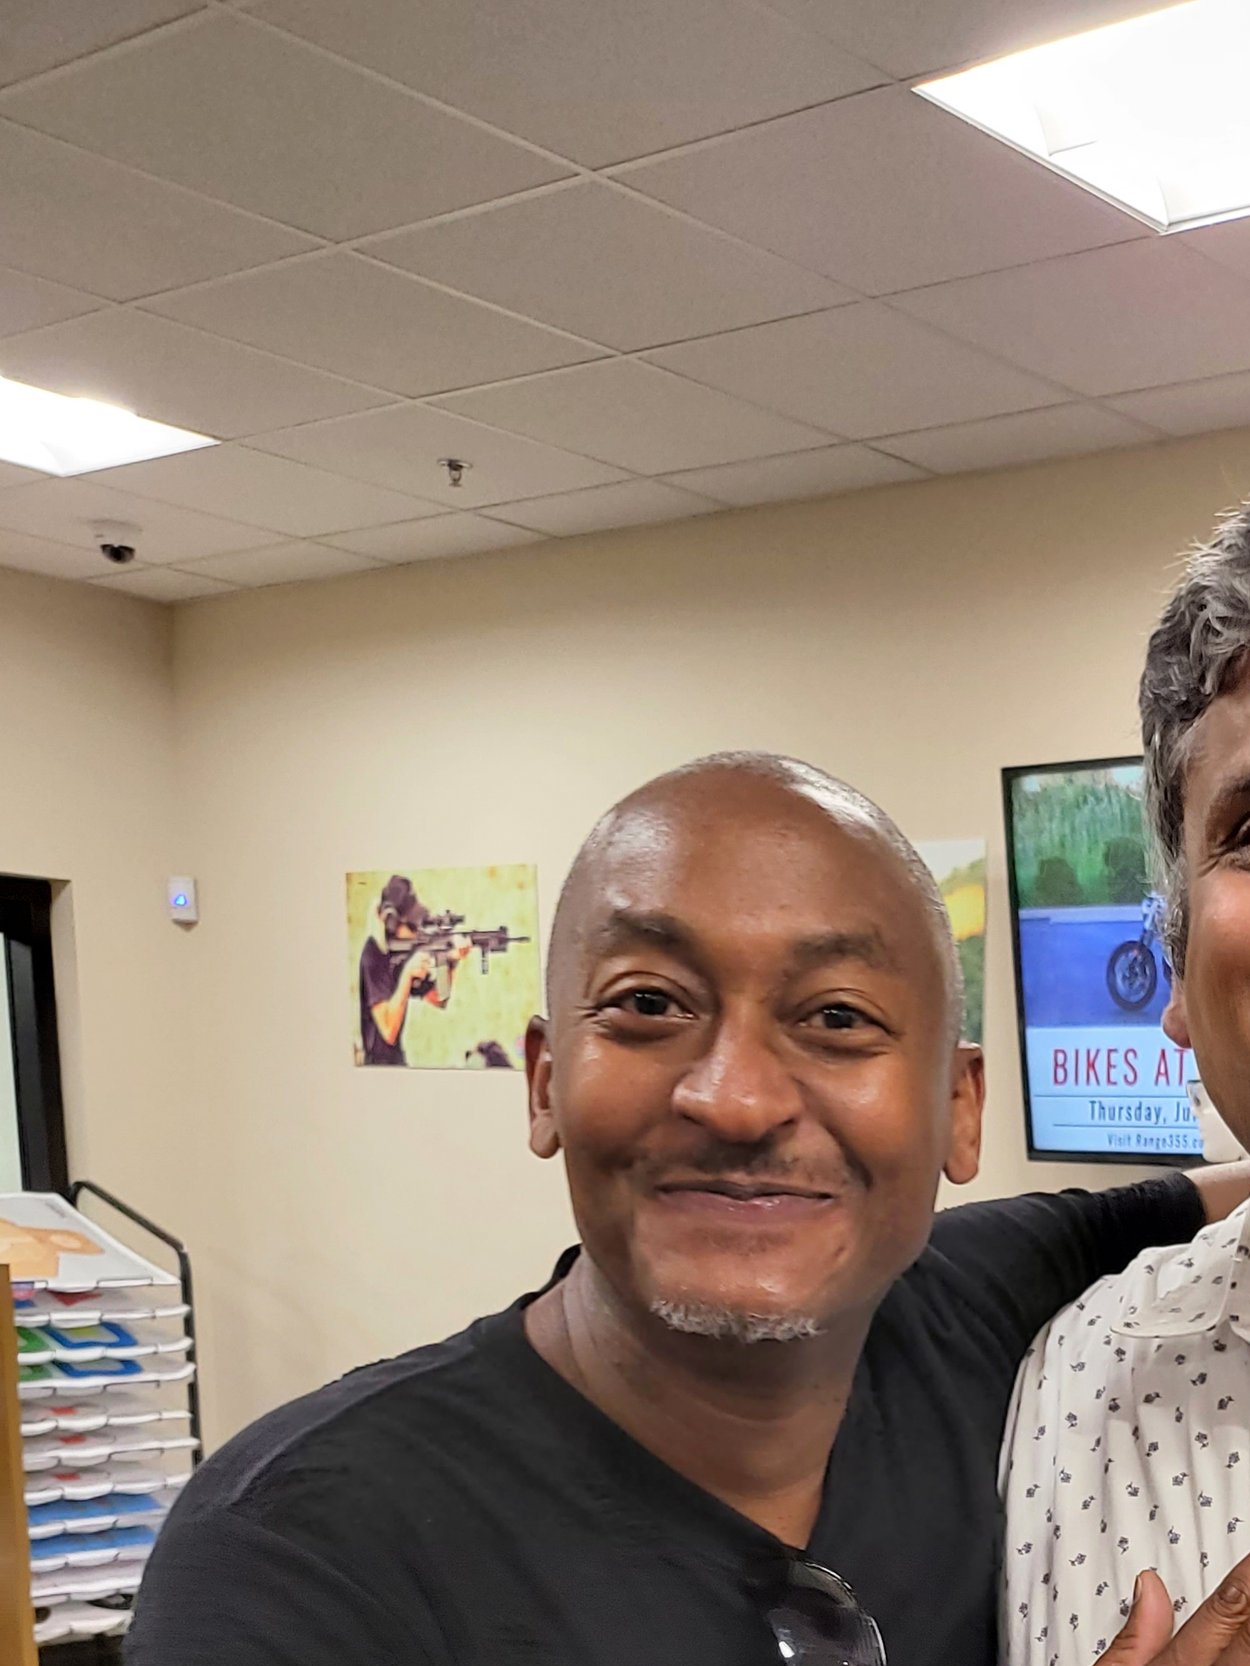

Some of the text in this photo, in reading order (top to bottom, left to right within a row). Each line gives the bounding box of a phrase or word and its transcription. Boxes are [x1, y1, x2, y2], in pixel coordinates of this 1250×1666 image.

[1053, 1048, 1188, 1087] BIKES AT
[1089, 1100, 1197, 1125] Thursday, Ju
[1107, 1133, 1132, 1148] Visit
